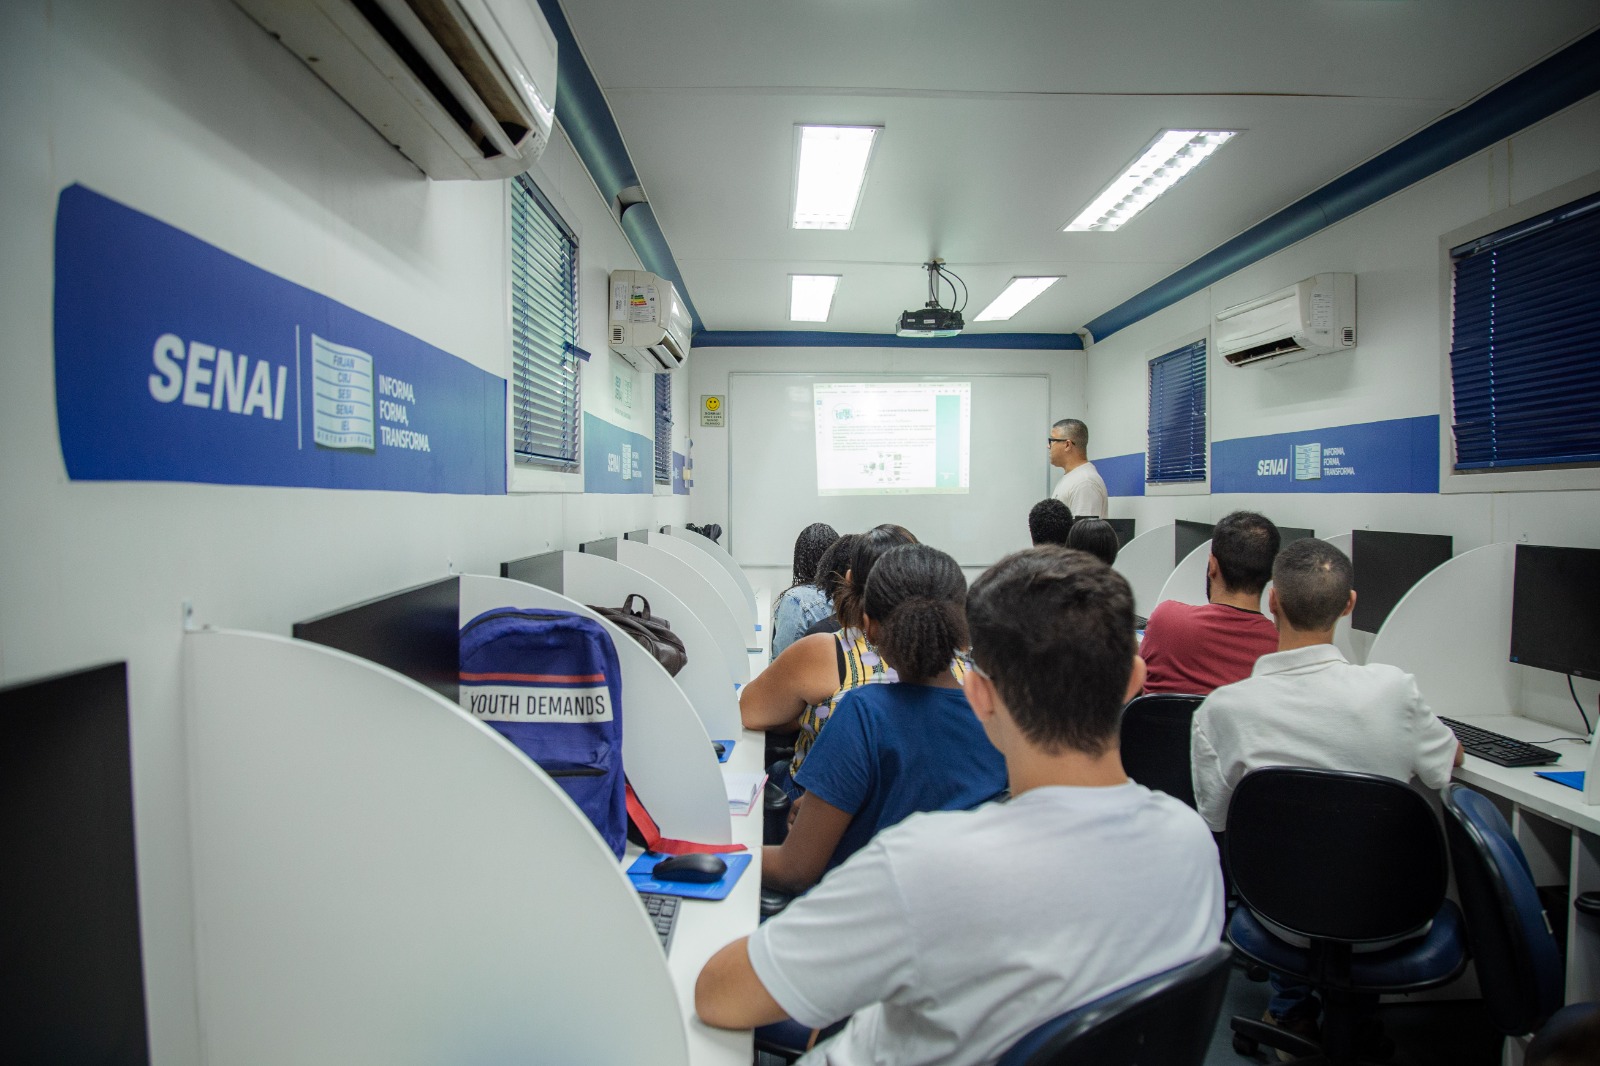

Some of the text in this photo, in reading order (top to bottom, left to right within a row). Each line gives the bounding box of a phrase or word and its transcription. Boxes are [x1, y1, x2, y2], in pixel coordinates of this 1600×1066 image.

[333, 354, 355, 369] FIRJAN
[148, 333, 288, 421] SENAI
[379, 374, 416, 405] INFORMA,
[379, 400, 409, 427] FORMA,
[380, 426, 431, 452] TRANSFORMA.
[1257, 458, 1288, 476] SENAI
[470, 694, 605, 716] YOUTH DEMANDS
